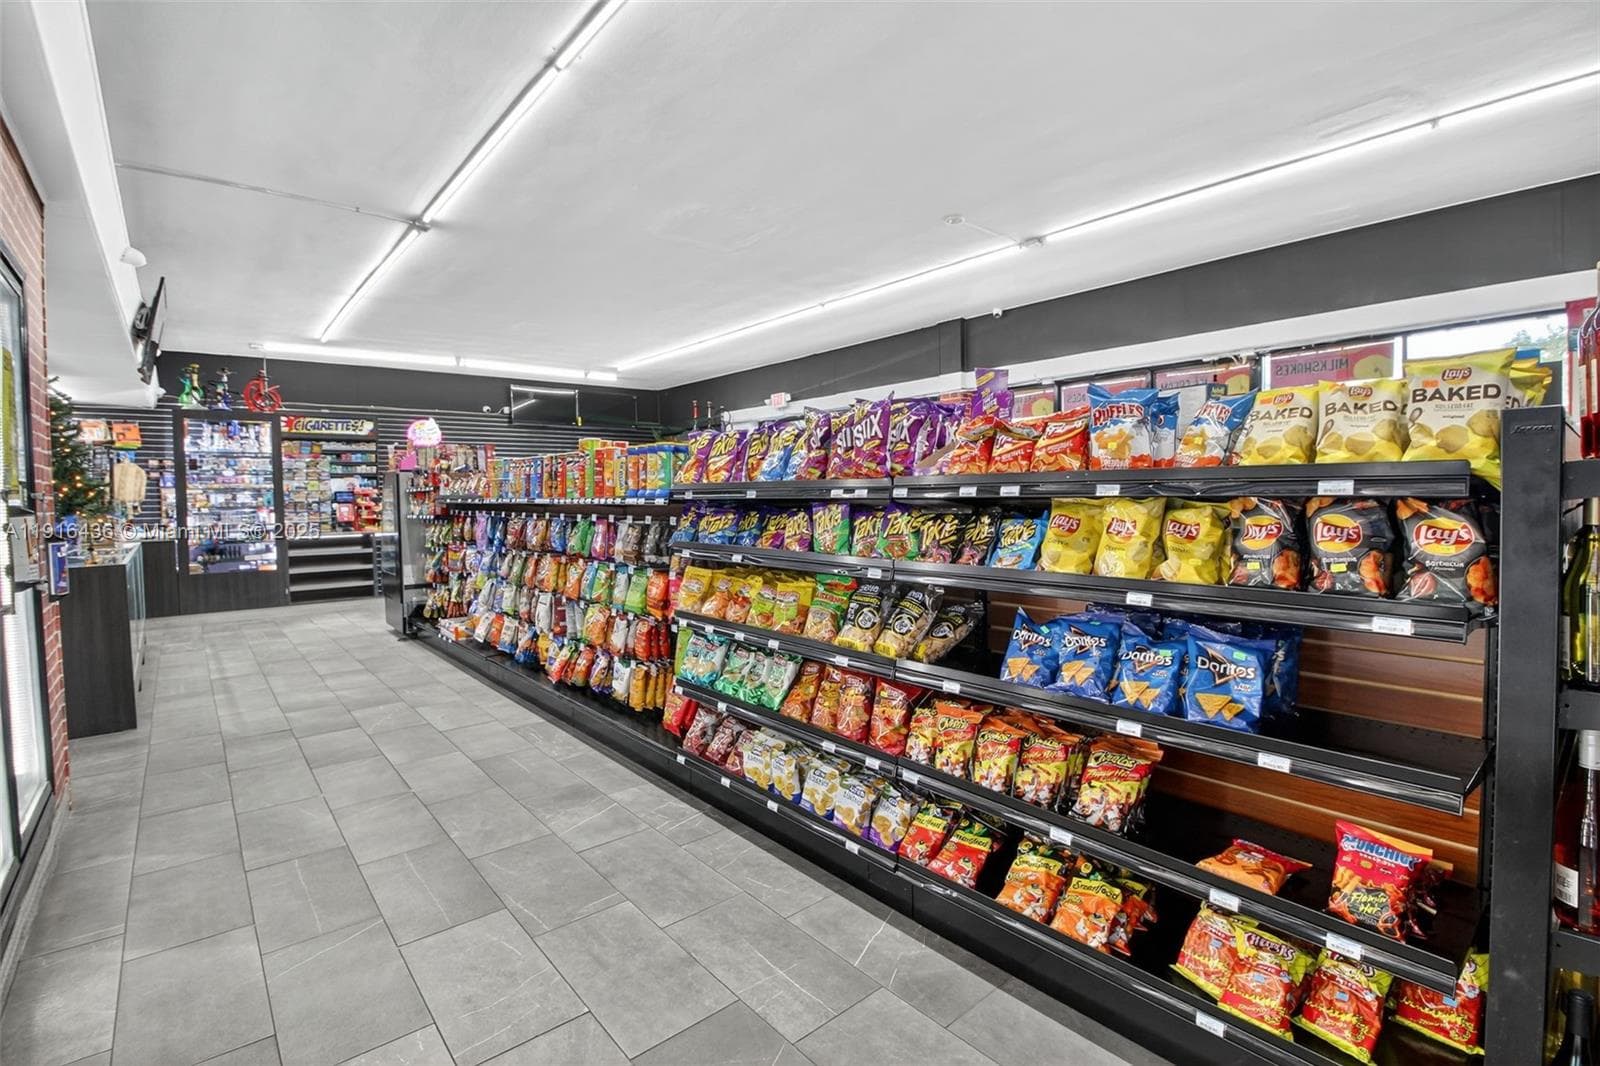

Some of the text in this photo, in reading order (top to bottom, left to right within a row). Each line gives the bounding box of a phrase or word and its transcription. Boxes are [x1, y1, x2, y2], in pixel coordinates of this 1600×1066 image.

[1411, 384, 1502, 404] BAKED
[1249, 406, 1313, 421] BAKED
[1325, 400, 1398, 416] BAKED
[854, 408, 883, 448] STIX
[1120, 651, 1173, 666] Doritos
[1197, 656, 1256, 679] Doritos
[1072, 880, 1120, 900] Smartfood
